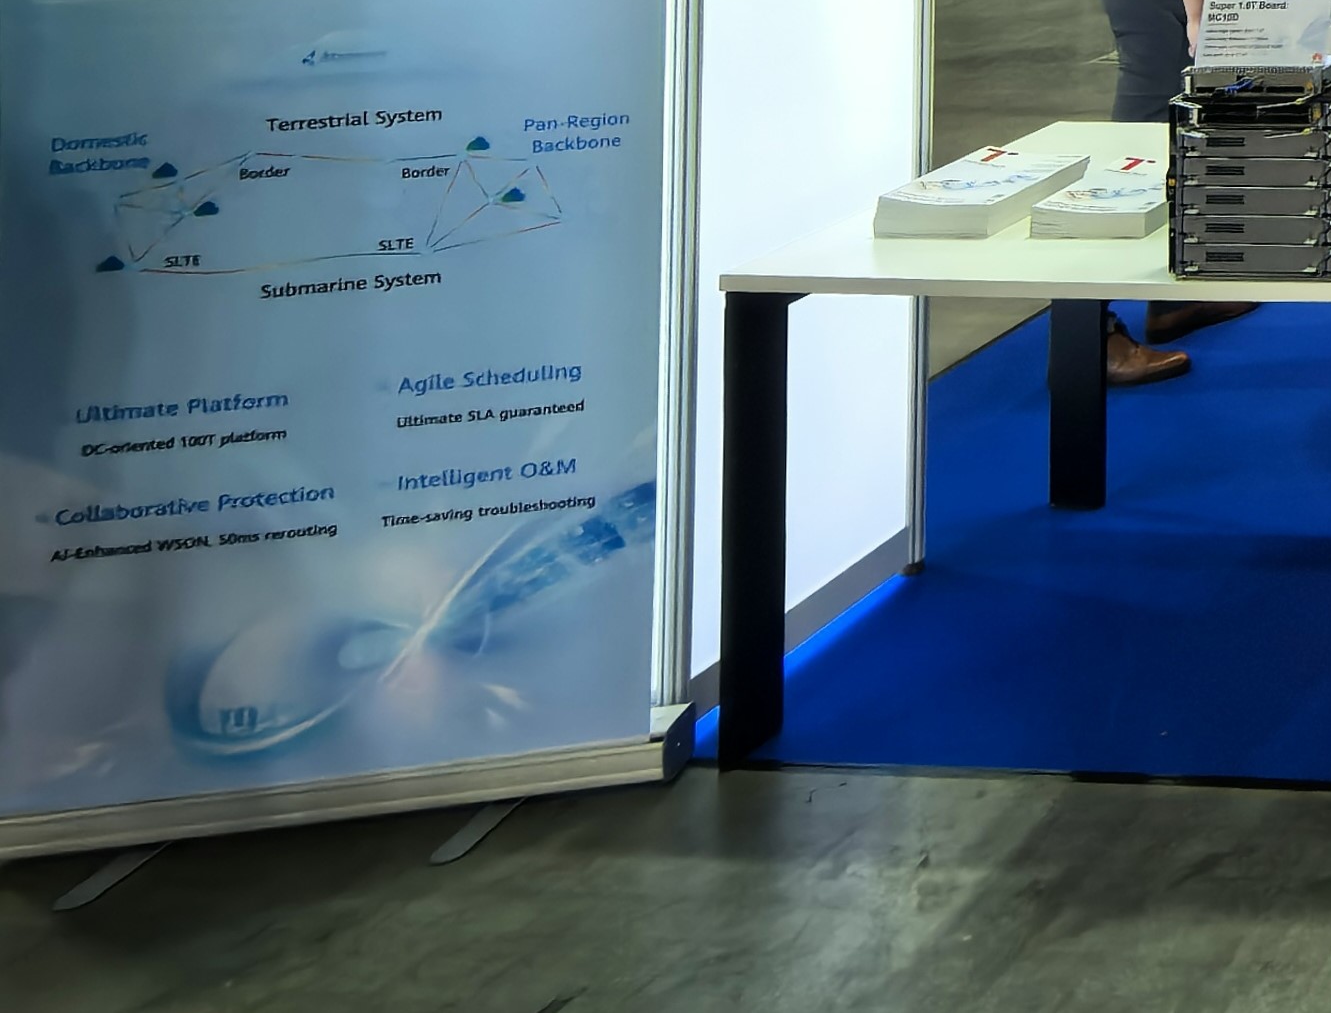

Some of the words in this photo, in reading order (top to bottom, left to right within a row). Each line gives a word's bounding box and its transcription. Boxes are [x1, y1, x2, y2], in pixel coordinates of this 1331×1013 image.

[266, 111, 369, 132] Terrestrial
[375, 109, 442, 128] System
[524, 113, 630, 132] Pan-Region
[51, 132, 148, 152] Domestic
[532, 136, 622, 154] Backbone
[239, 166, 291, 181] Border
[401, 165, 451, 179] Border
[260, 278, 367, 299] Submarine
[374, 272, 442, 292] System
[398, 376, 455, 397] Agile
[463, 365, 582, 387] Scheduling
[76, 402, 179, 424] Ultimate
[187, 393, 289, 414] Platform
[467, 409, 495, 423] SLA
[500, 399, 585, 422] guaranteed
[398, 468, 513, 491] Intelligent
[521, 458, 577, 479] O&M
[56, 498, 210, 526] Collaborative
[217, 486, 335, 511] Protection
[478, 495, 596, 517] troubleshooting
